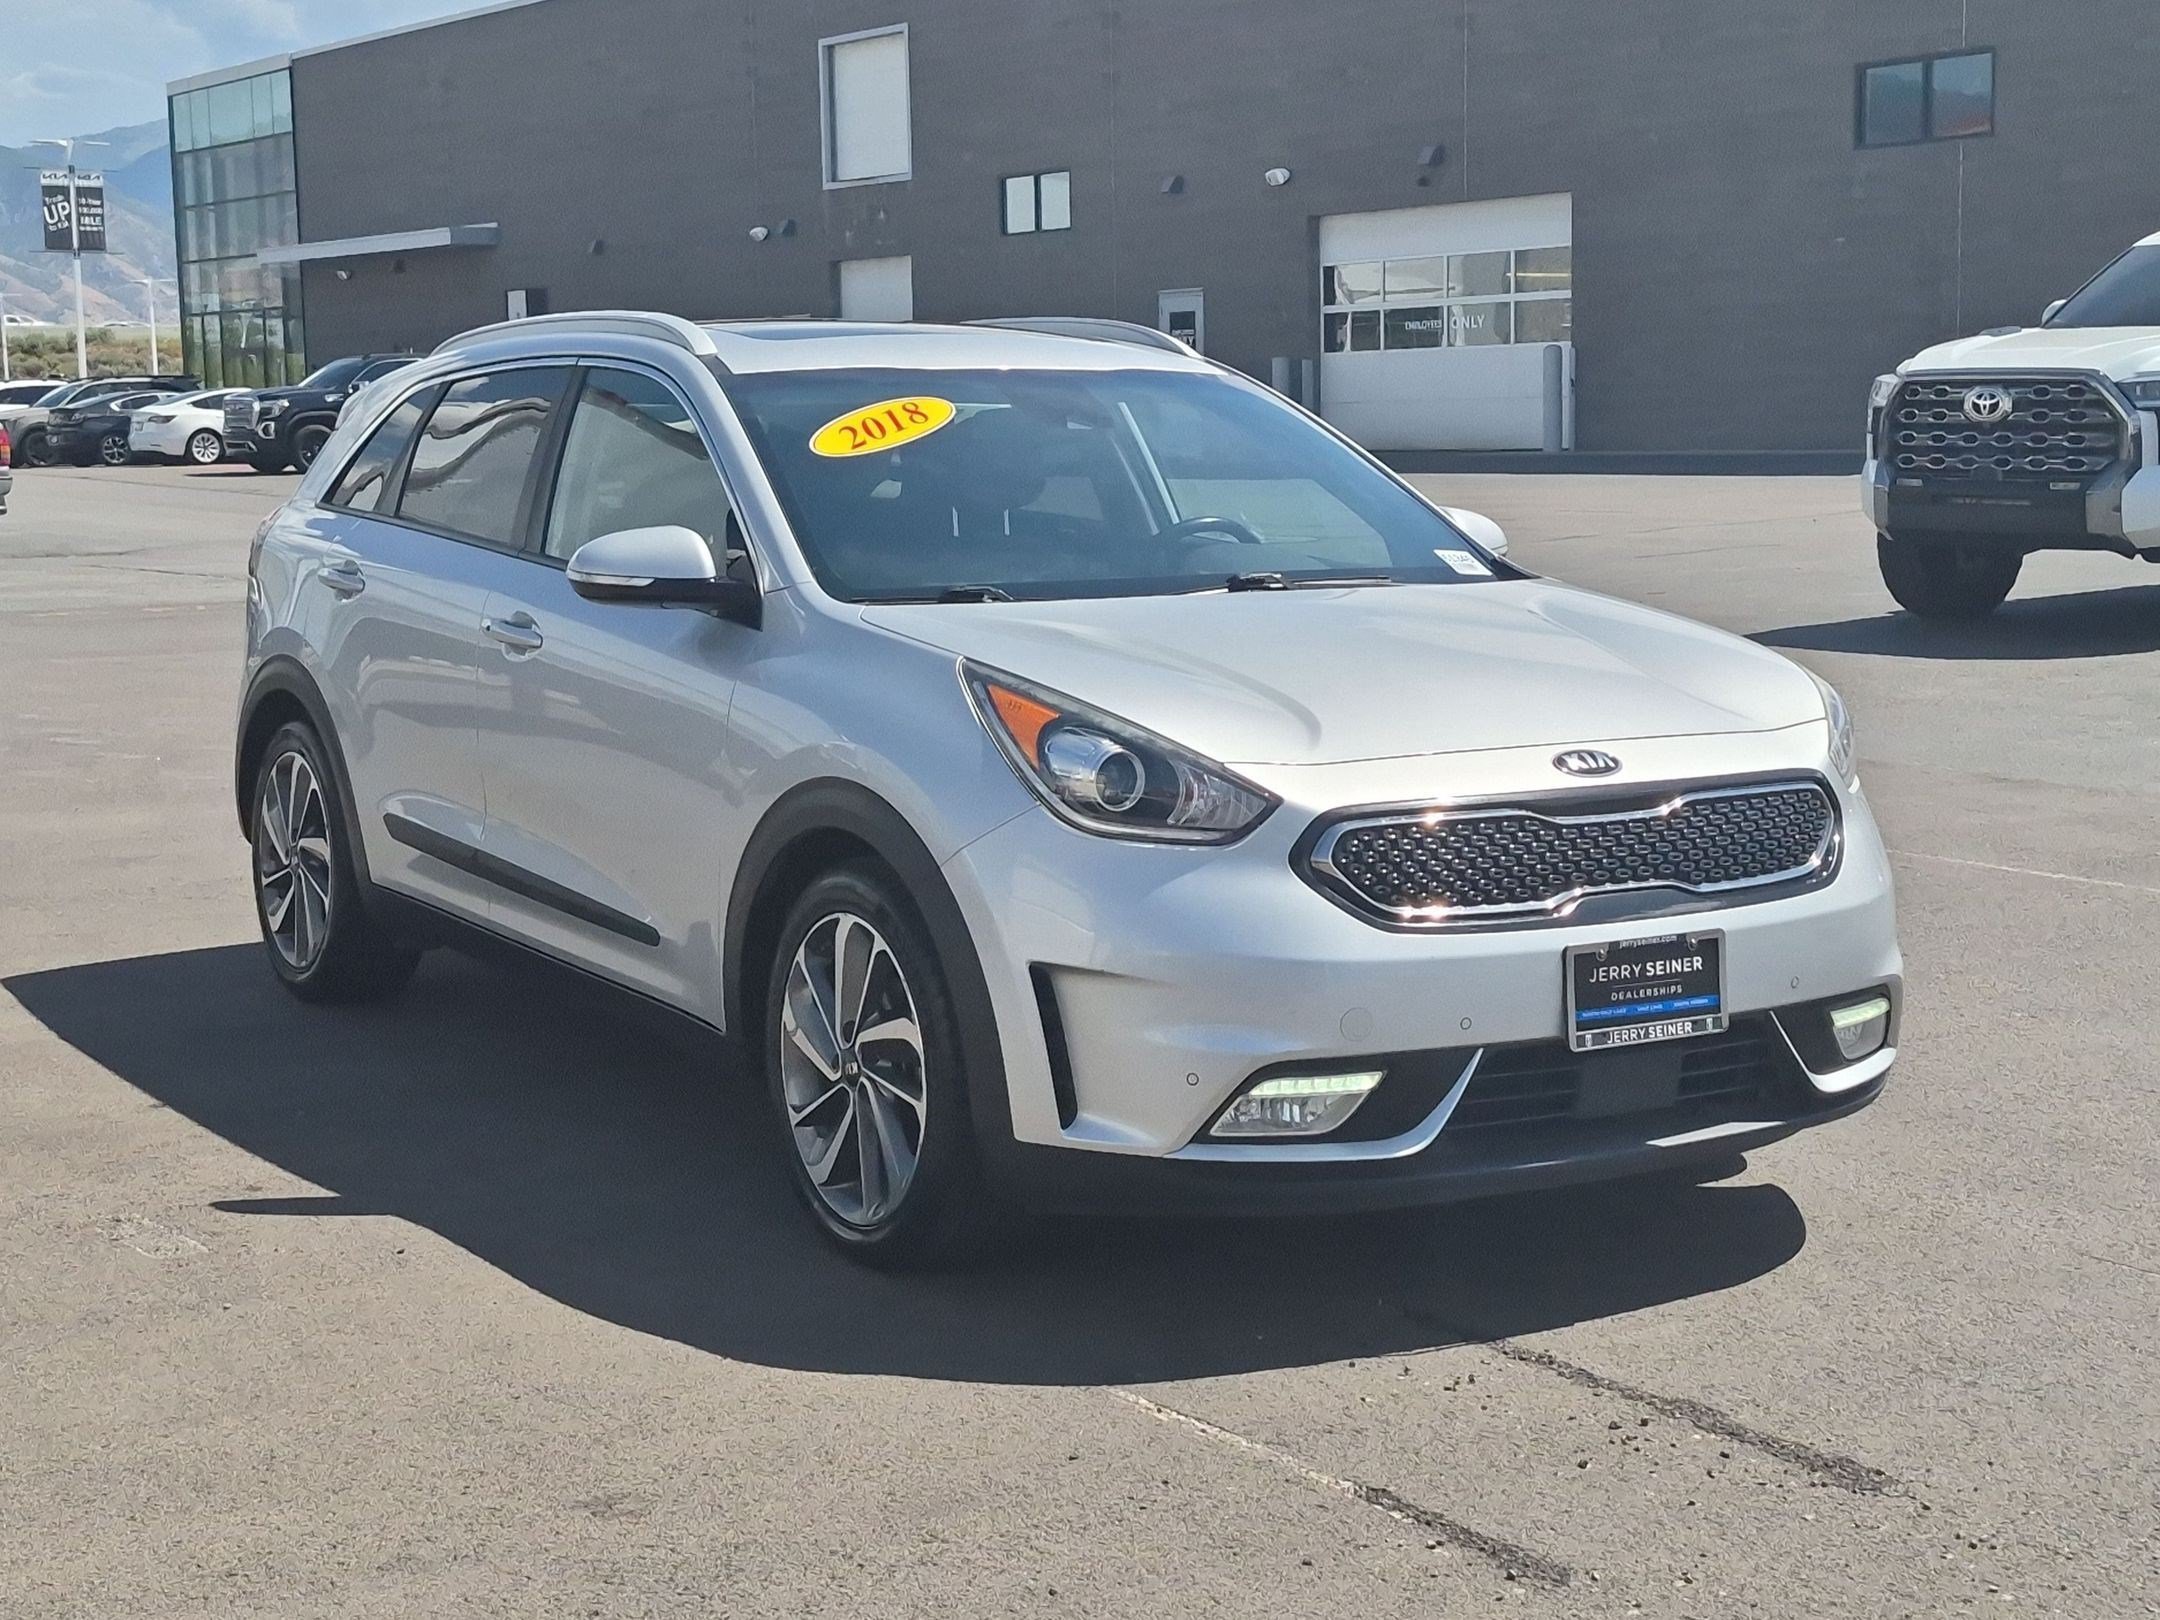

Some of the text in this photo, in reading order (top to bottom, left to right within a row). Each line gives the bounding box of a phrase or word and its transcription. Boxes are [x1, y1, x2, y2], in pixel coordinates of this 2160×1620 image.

[43, 201, 70, 224] UP
[1451, 314, 1485, 329] ONLY
[838, 402, 929, 449] 2018
[1589, 956, 1703, 983] JERRY SEINER
[1610, 984, 1683, 1001] DEALERSHIPS
[1606, 1021, 1693, 1044] JERRY SEINER
